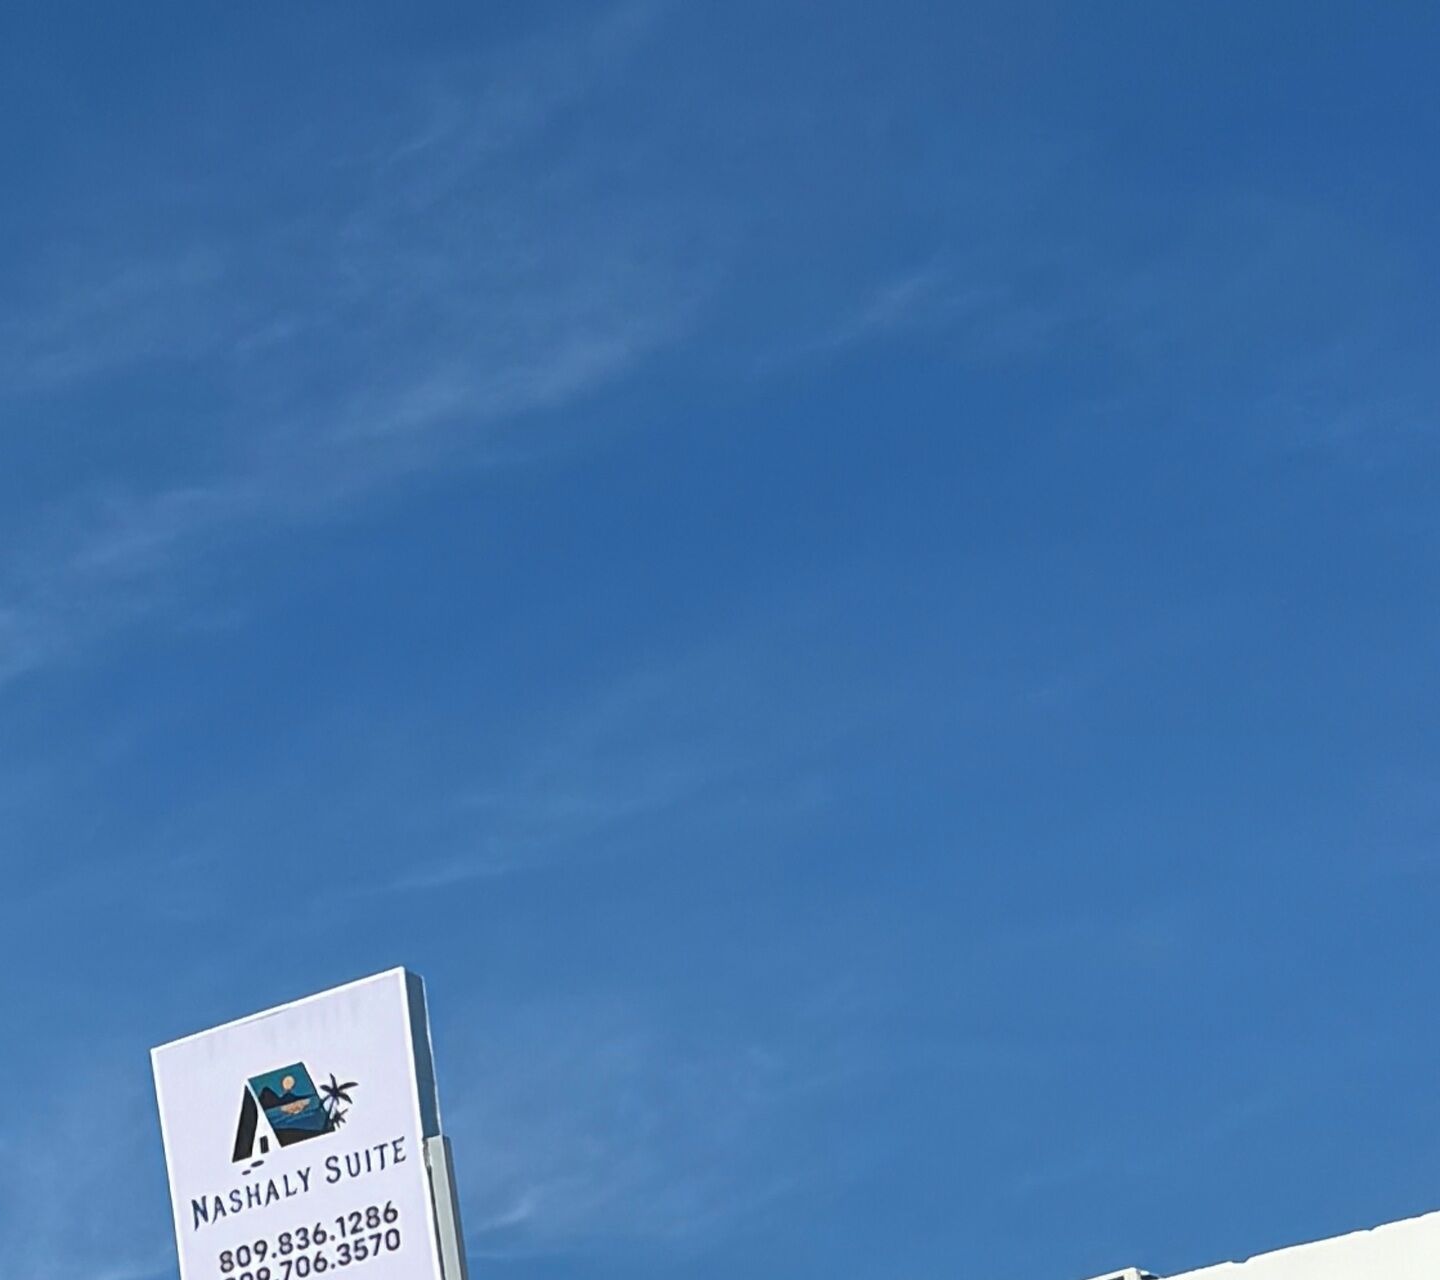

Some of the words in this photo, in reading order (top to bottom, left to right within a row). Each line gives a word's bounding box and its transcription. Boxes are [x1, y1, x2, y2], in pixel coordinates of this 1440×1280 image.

[191, 1167, 311, 1230] NASHALY
[326, 1136, 407, 1184] SUITE
[219, 1201, 398, 1274] 809.836.1286
